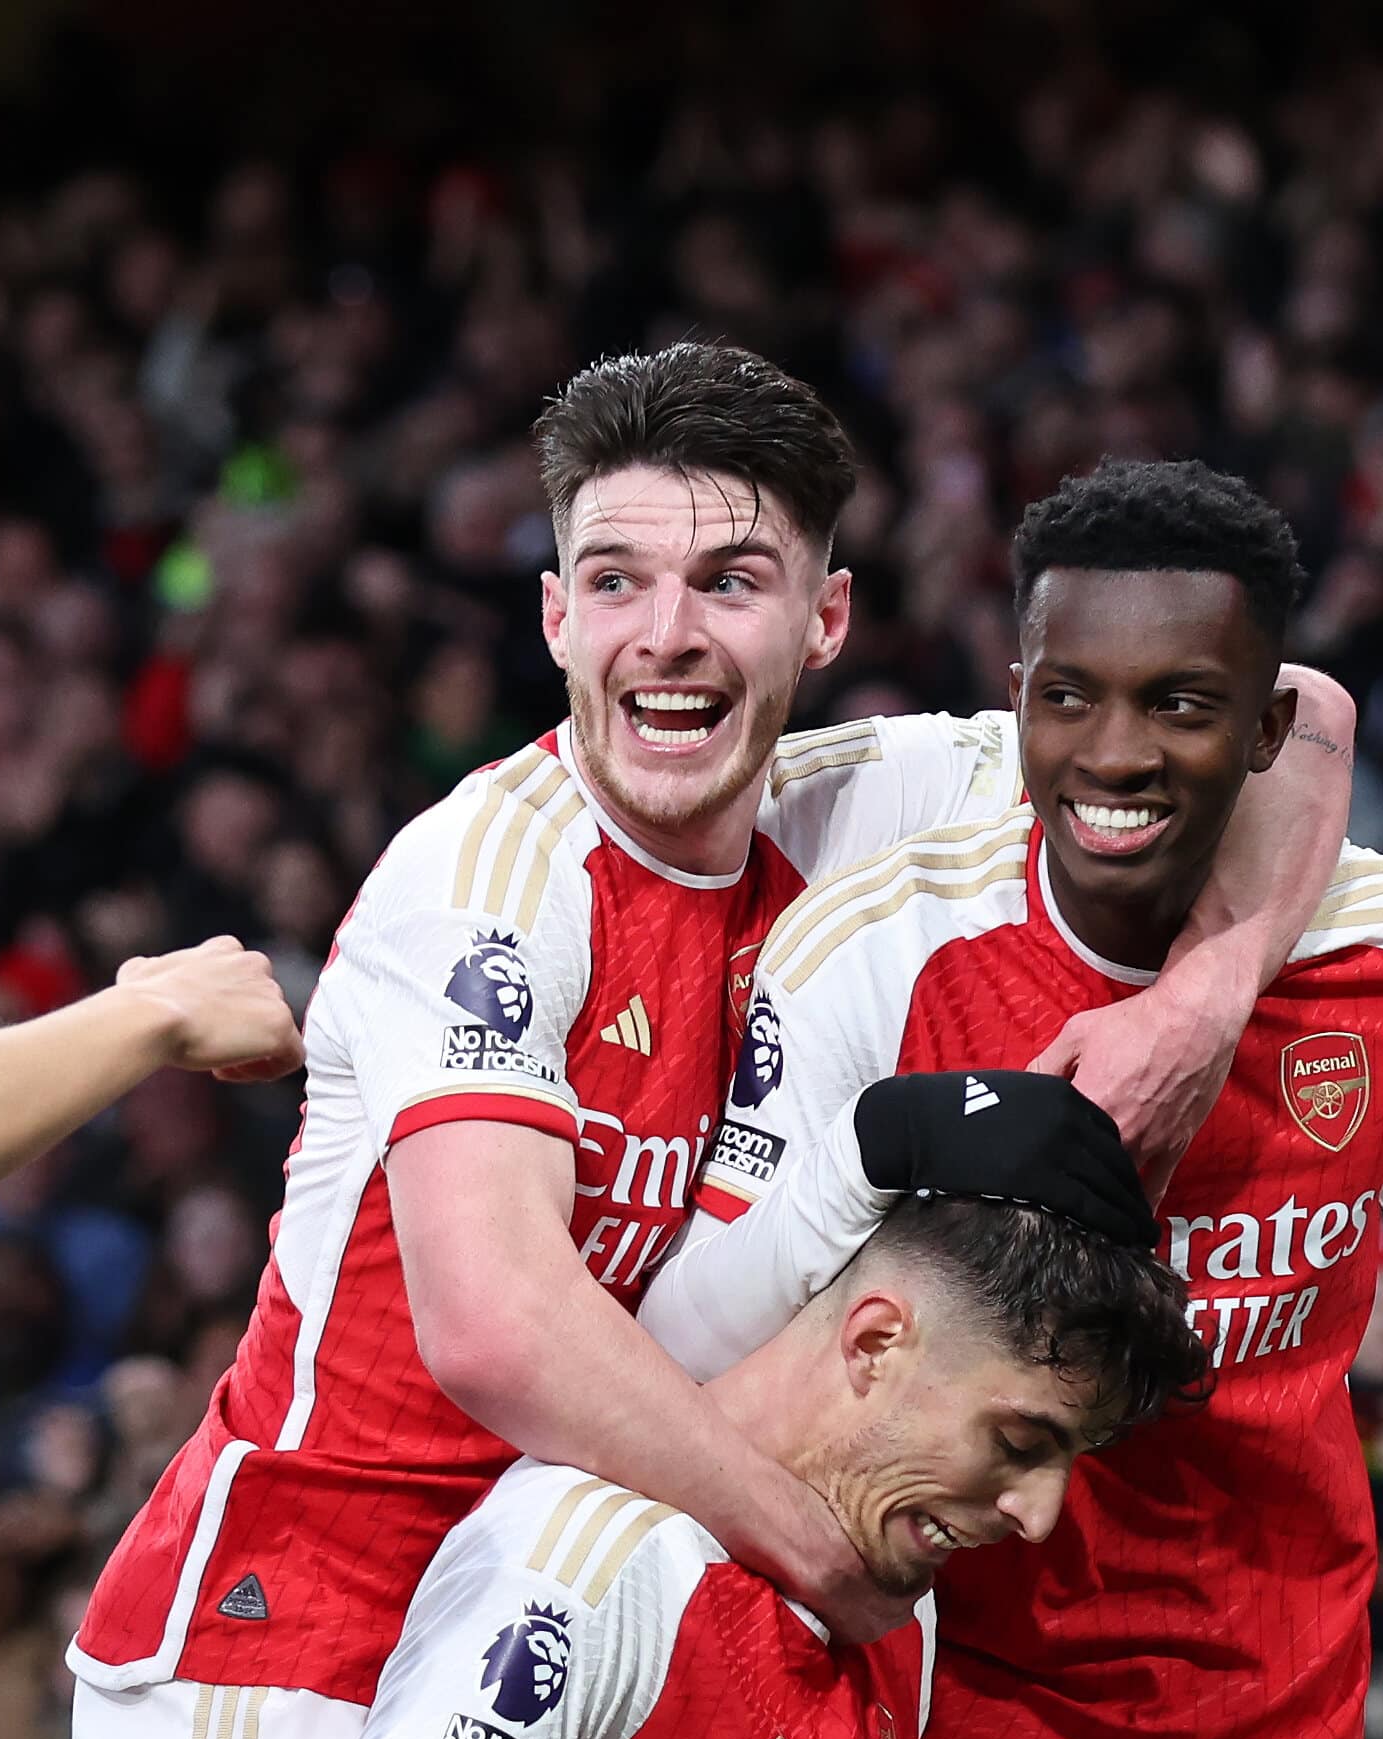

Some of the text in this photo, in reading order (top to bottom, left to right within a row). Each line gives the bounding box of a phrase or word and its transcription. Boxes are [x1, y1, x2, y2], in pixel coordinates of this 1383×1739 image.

[444, 1026, 482, 1051] No
[482, 1050, 560, 1084] racism
[1293, 1050, 1356, 1078] Arsenal
[714, 1144, 775, 1182] acism
[1166, 1189, 1377, 1283] rates
